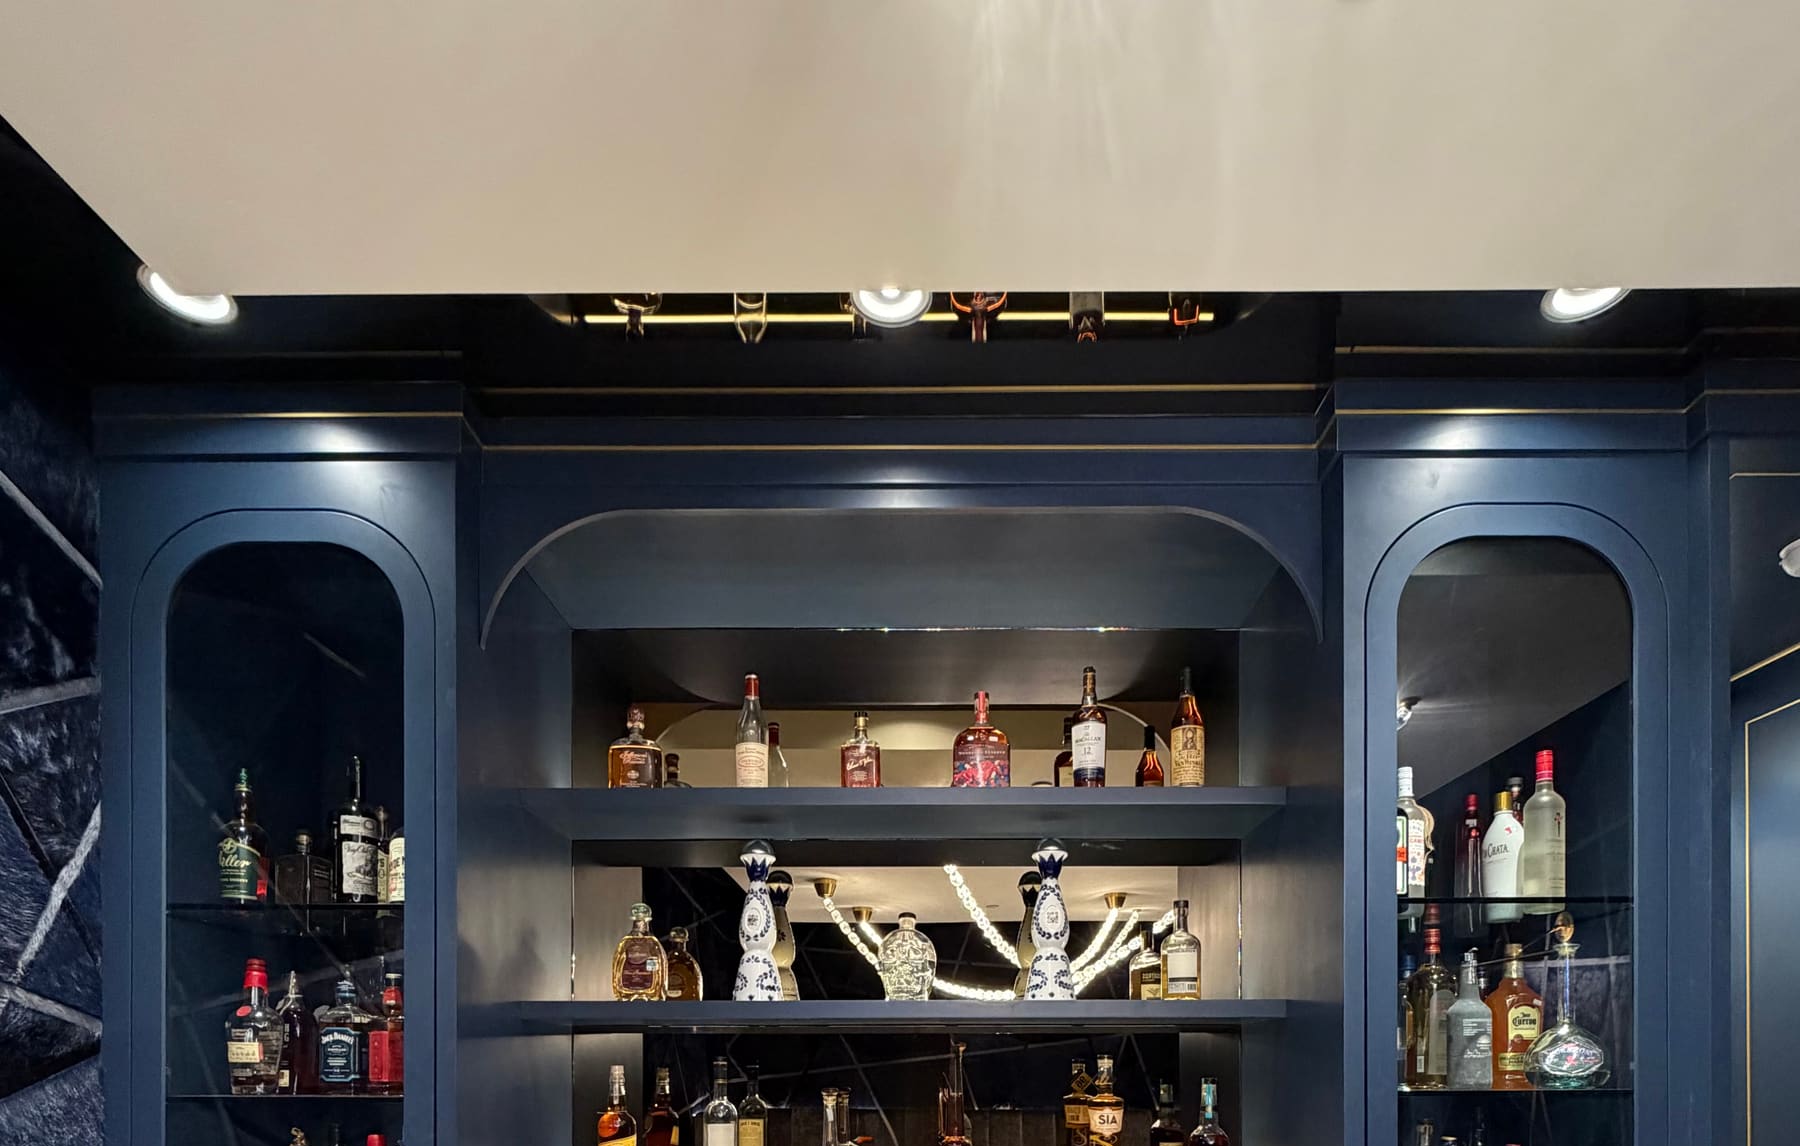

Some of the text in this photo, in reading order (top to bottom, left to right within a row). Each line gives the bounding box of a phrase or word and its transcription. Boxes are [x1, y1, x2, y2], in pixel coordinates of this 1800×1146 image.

[1083, 747, 1092, 755] 12
[1512, 1018, 1536, 1027] Cuervo
[1098, 1115, 1118, 1125] SIA
